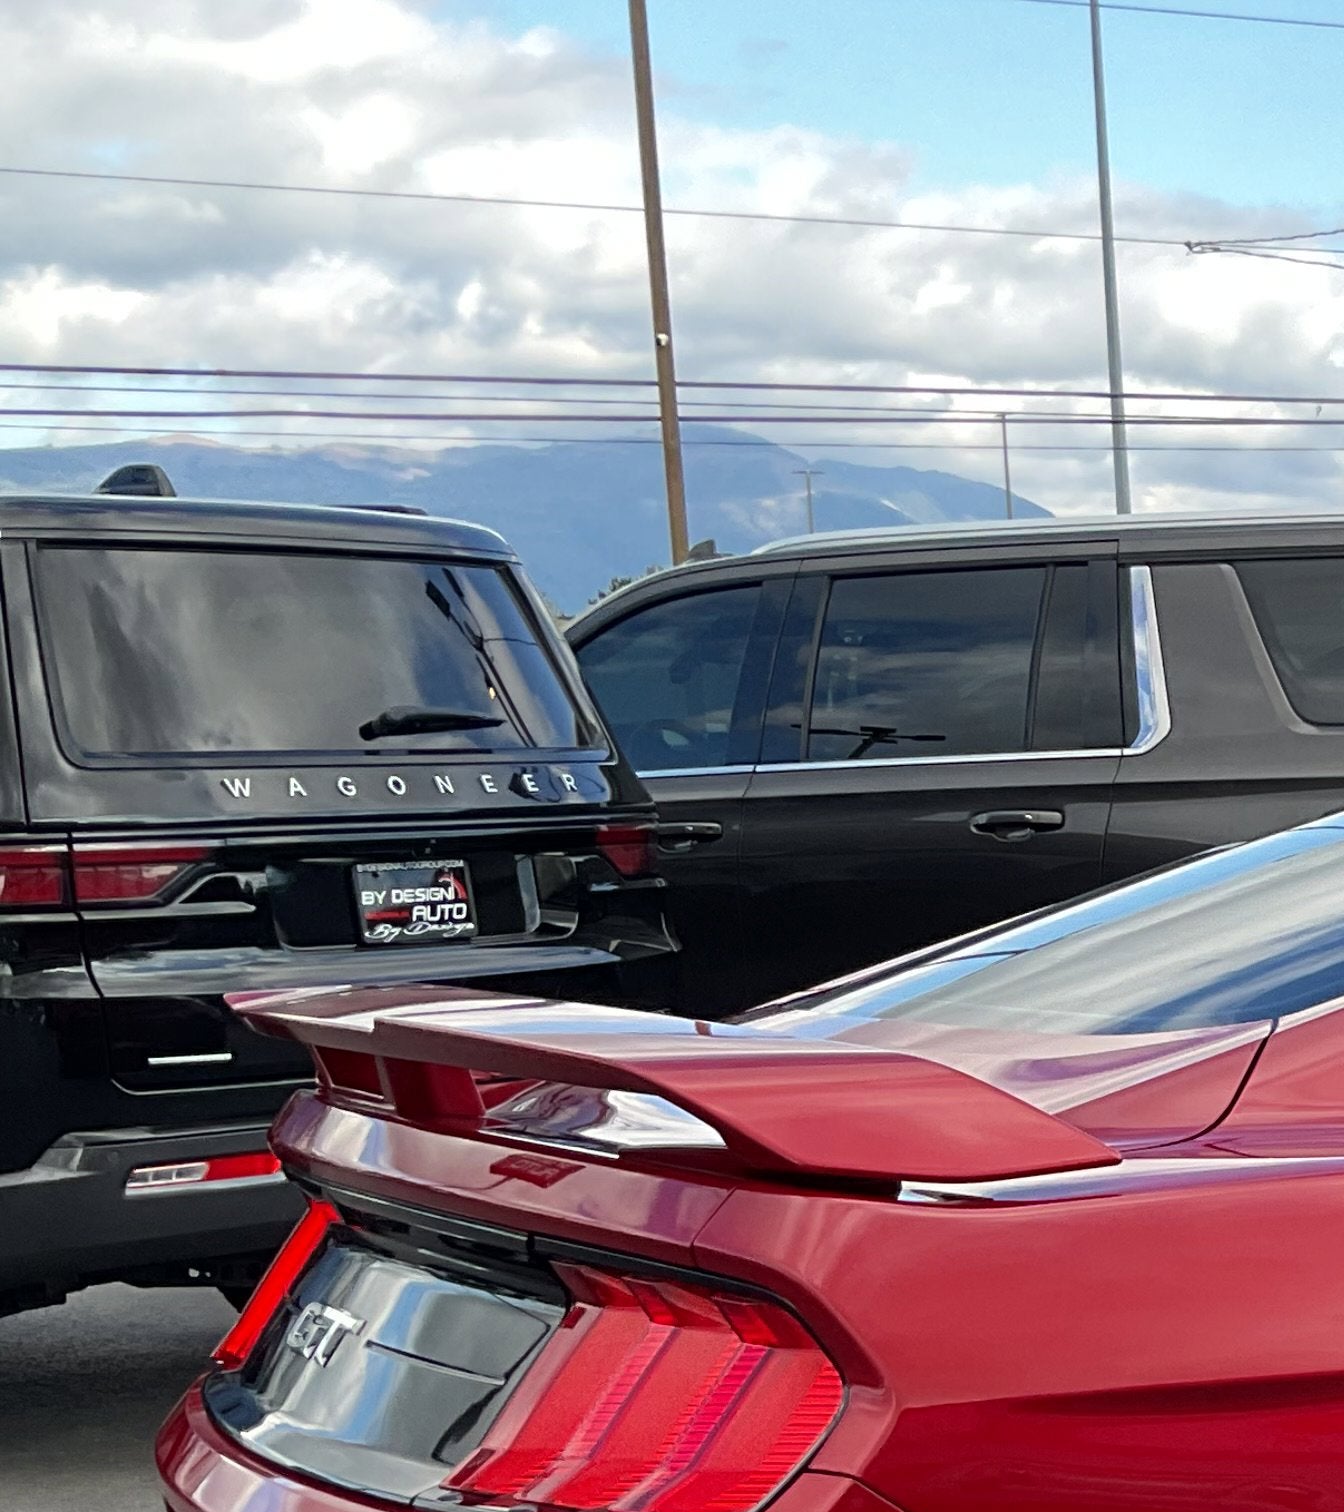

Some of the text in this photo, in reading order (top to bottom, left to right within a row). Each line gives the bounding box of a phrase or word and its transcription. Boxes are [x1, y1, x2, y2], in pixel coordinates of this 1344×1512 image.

[220, 773, 578, 798] WAGONEER
[361, 886, 455, 906] BY DESIGN
[412, 902, 468, 921] AUTO
[286, 1301, 367, 1368] GT
